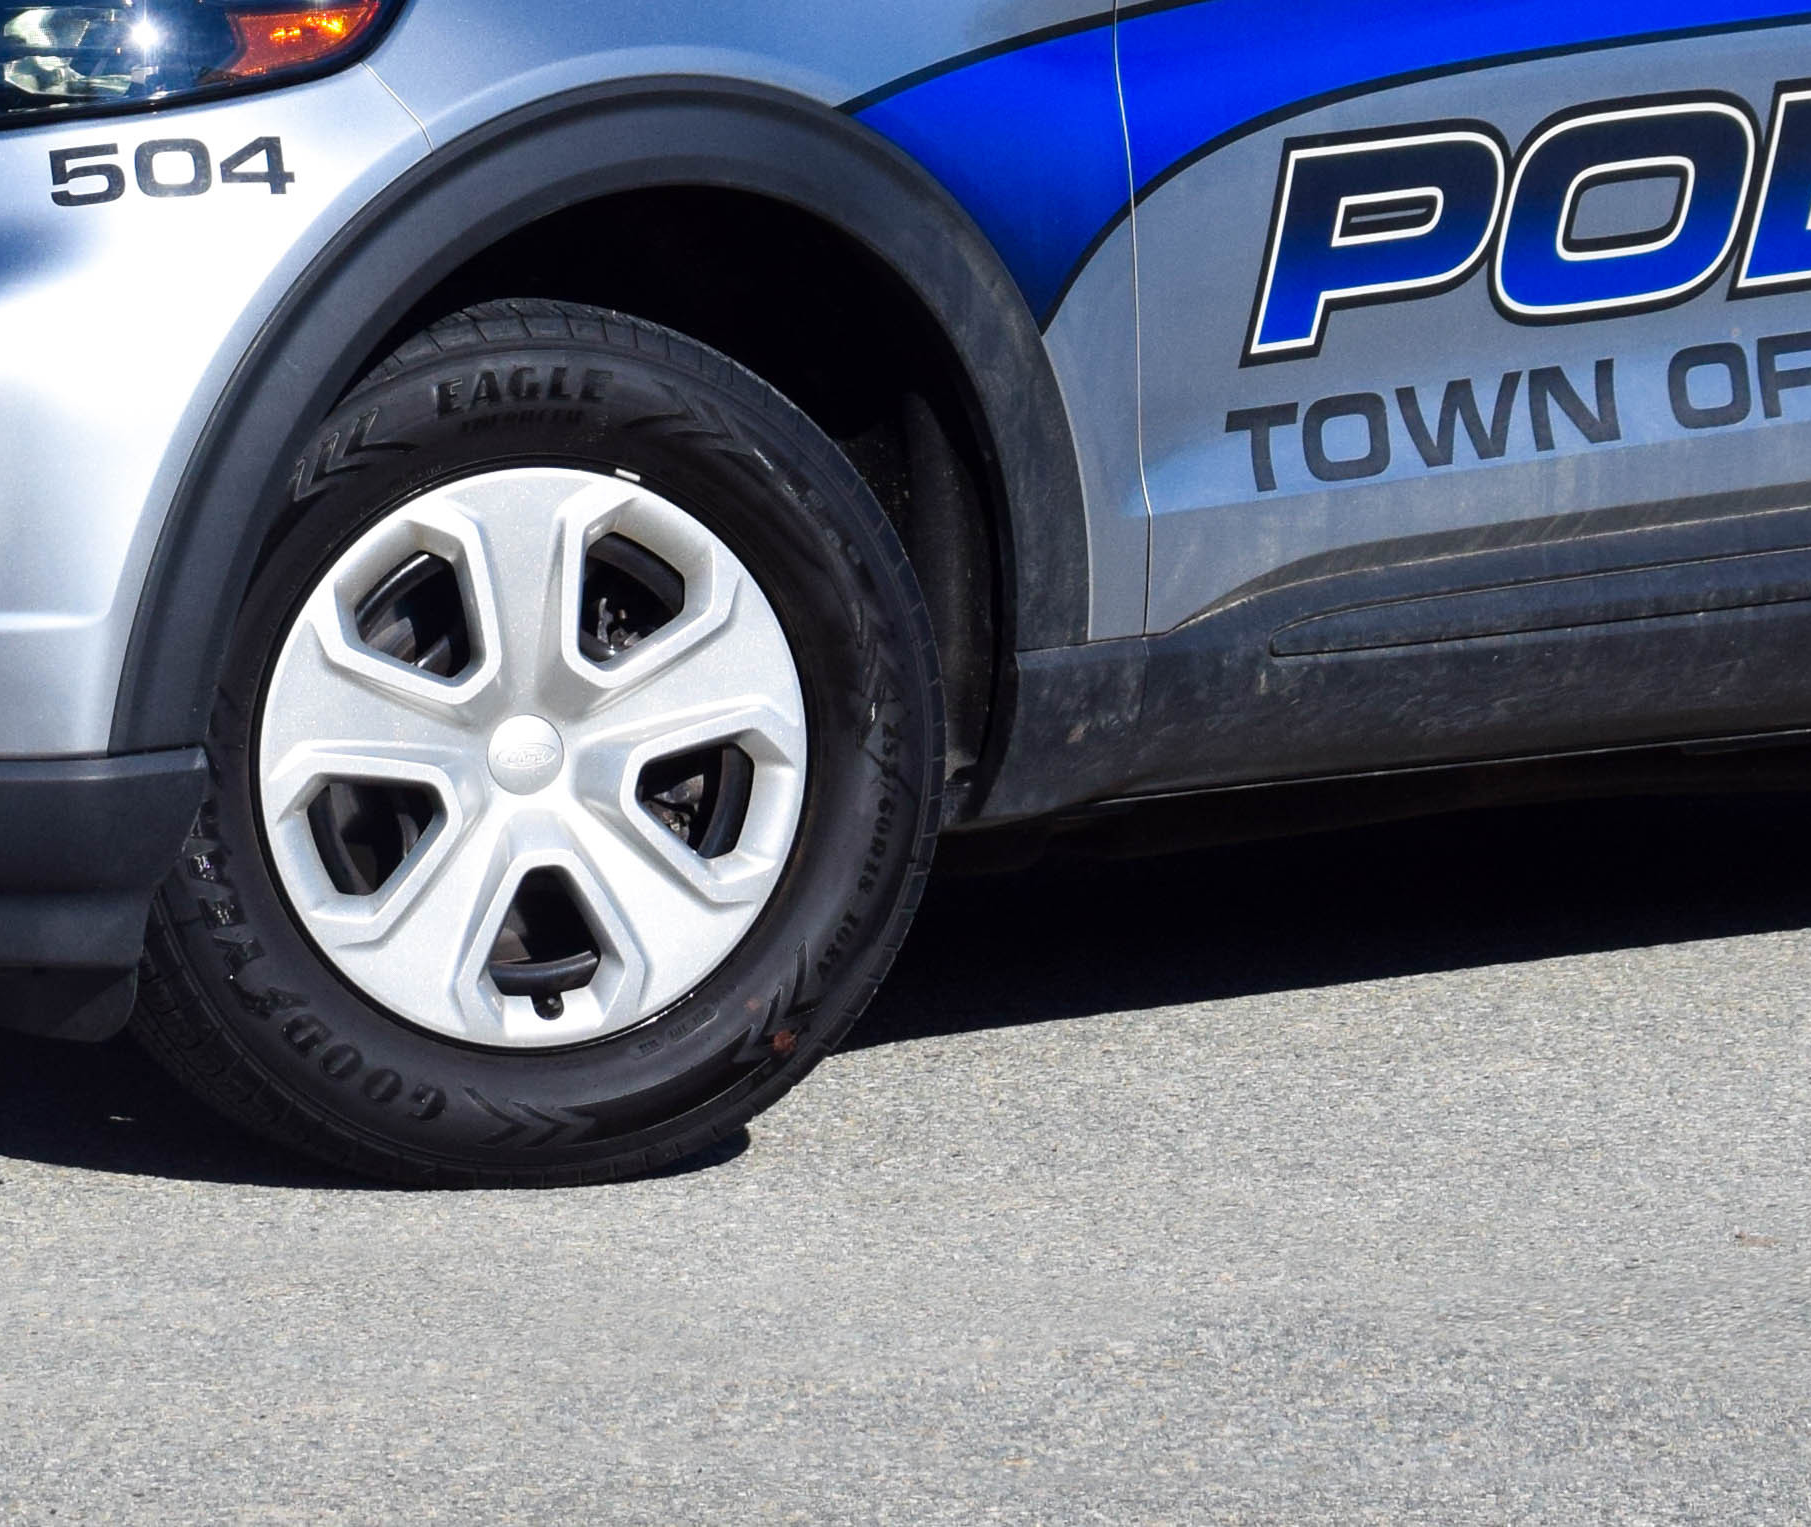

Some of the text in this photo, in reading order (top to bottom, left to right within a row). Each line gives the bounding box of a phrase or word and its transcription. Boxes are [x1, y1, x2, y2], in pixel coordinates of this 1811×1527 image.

[49, 136, 295, 207] 504
[433, 365, 615, 417] EAGLE
[1224, 359, 1622, 492] TOWN
